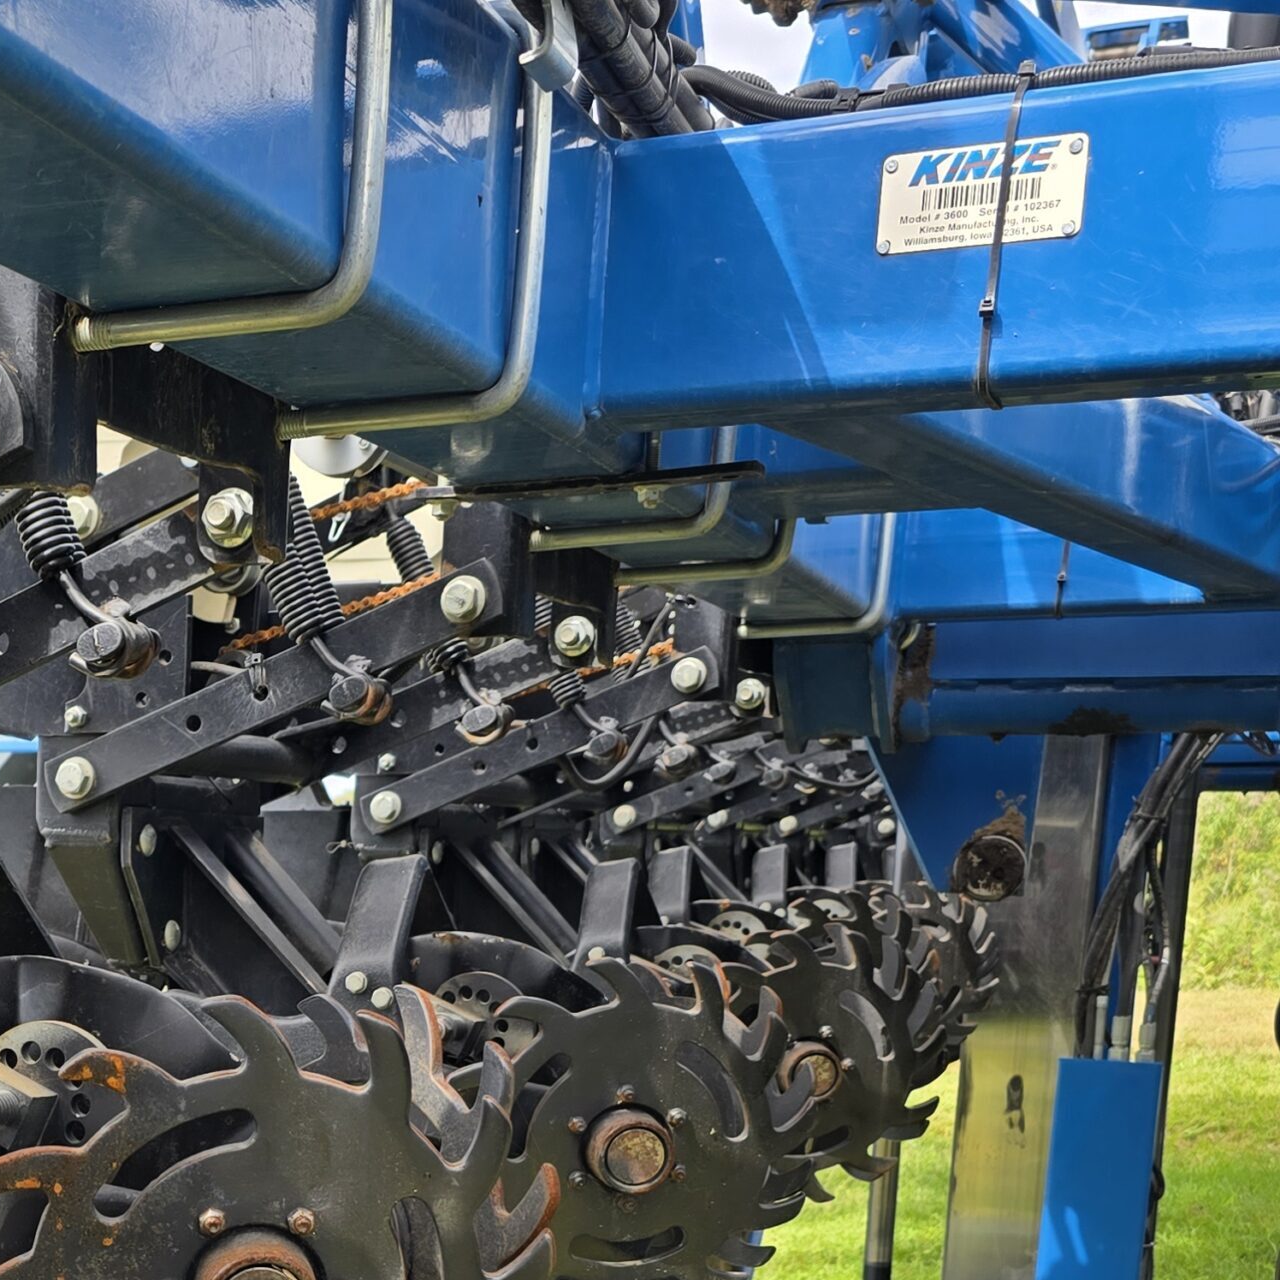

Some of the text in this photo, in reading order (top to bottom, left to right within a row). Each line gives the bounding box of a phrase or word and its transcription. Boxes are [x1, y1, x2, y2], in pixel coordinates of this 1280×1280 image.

[908, 140, 1062, 187] KINZE
[899, 199, 1062, 225] Model # 3600 Serl # 102367
[904, 223, 1054, 246] Williamsburg, Iowa 2361, USA
[919, 215, 1040, 234] Kinze Manufactung, Inc.
